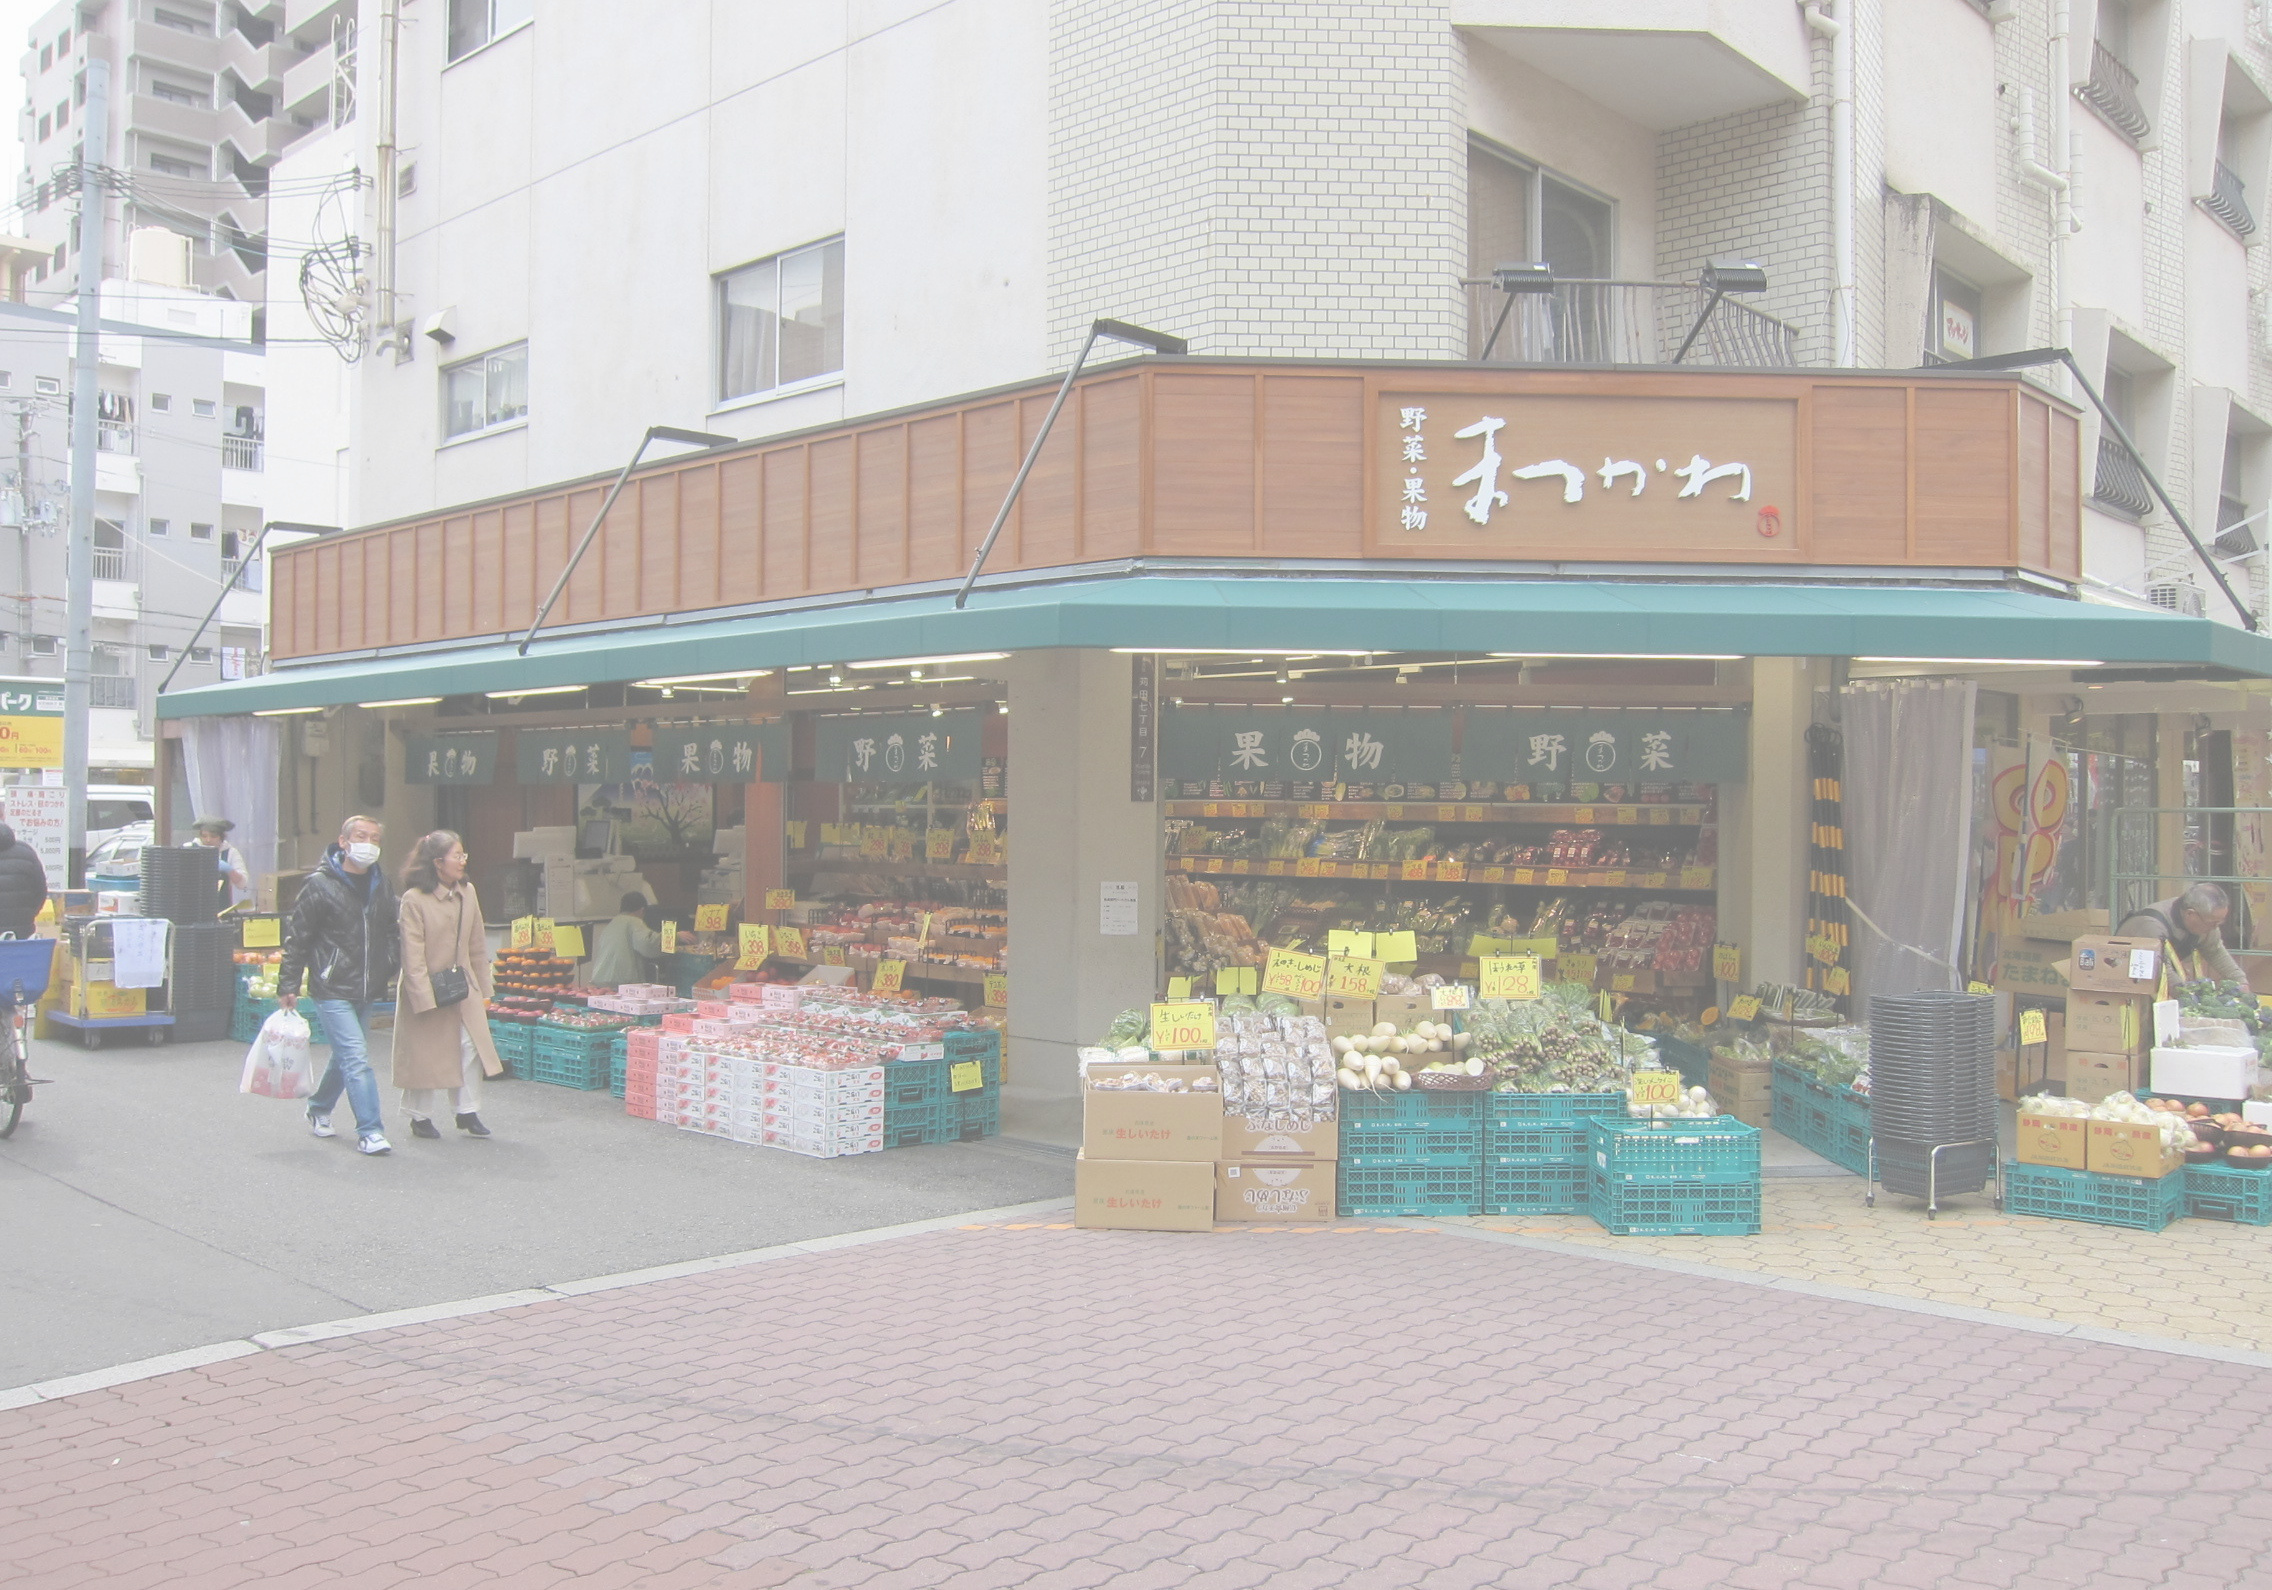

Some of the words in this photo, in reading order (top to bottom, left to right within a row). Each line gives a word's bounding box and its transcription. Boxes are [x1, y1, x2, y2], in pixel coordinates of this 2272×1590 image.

[1399, 407, 1428, 531] 野菜・果物
[1452, 416, 1752, 525] まつかわ
[541, 749, 558, 776] 野
[587, 744, 600, 775] 菜
[681, 743, 700, 774] 果
[733, 741, 752, 773] 物
[853, 738, 877, 772] 野
[918, 733, 938, 772] 菜
[1139, 746, 1148, 758] 7
[1229, 731, 1269, 771] 果
[1345, 732, 1384, 770] 物
[1527, 734, 1567, 771] 野
[1638, 731, 1674, 771] 菜
[428, 751, 440, 777] 果
[461, 750, 477, 776] 物
[1345, 963, 1371, 976] 大根
[1340, 976, 1368, 992] 158
[1498, 975, 1529, 995] 128
[1160, 1009, 1202, 1023] 生しいたけ
[1173, 1028, 1201, 1044] 100
[1646, 1084, 1675, 1100] 100
[1115, 1128, 1171, 1140] 生しいたけ
[1106, 1197, 1162, 1209] 生しいたけ
[1244, 1188, 1309, 1203] ぶなしめじ
